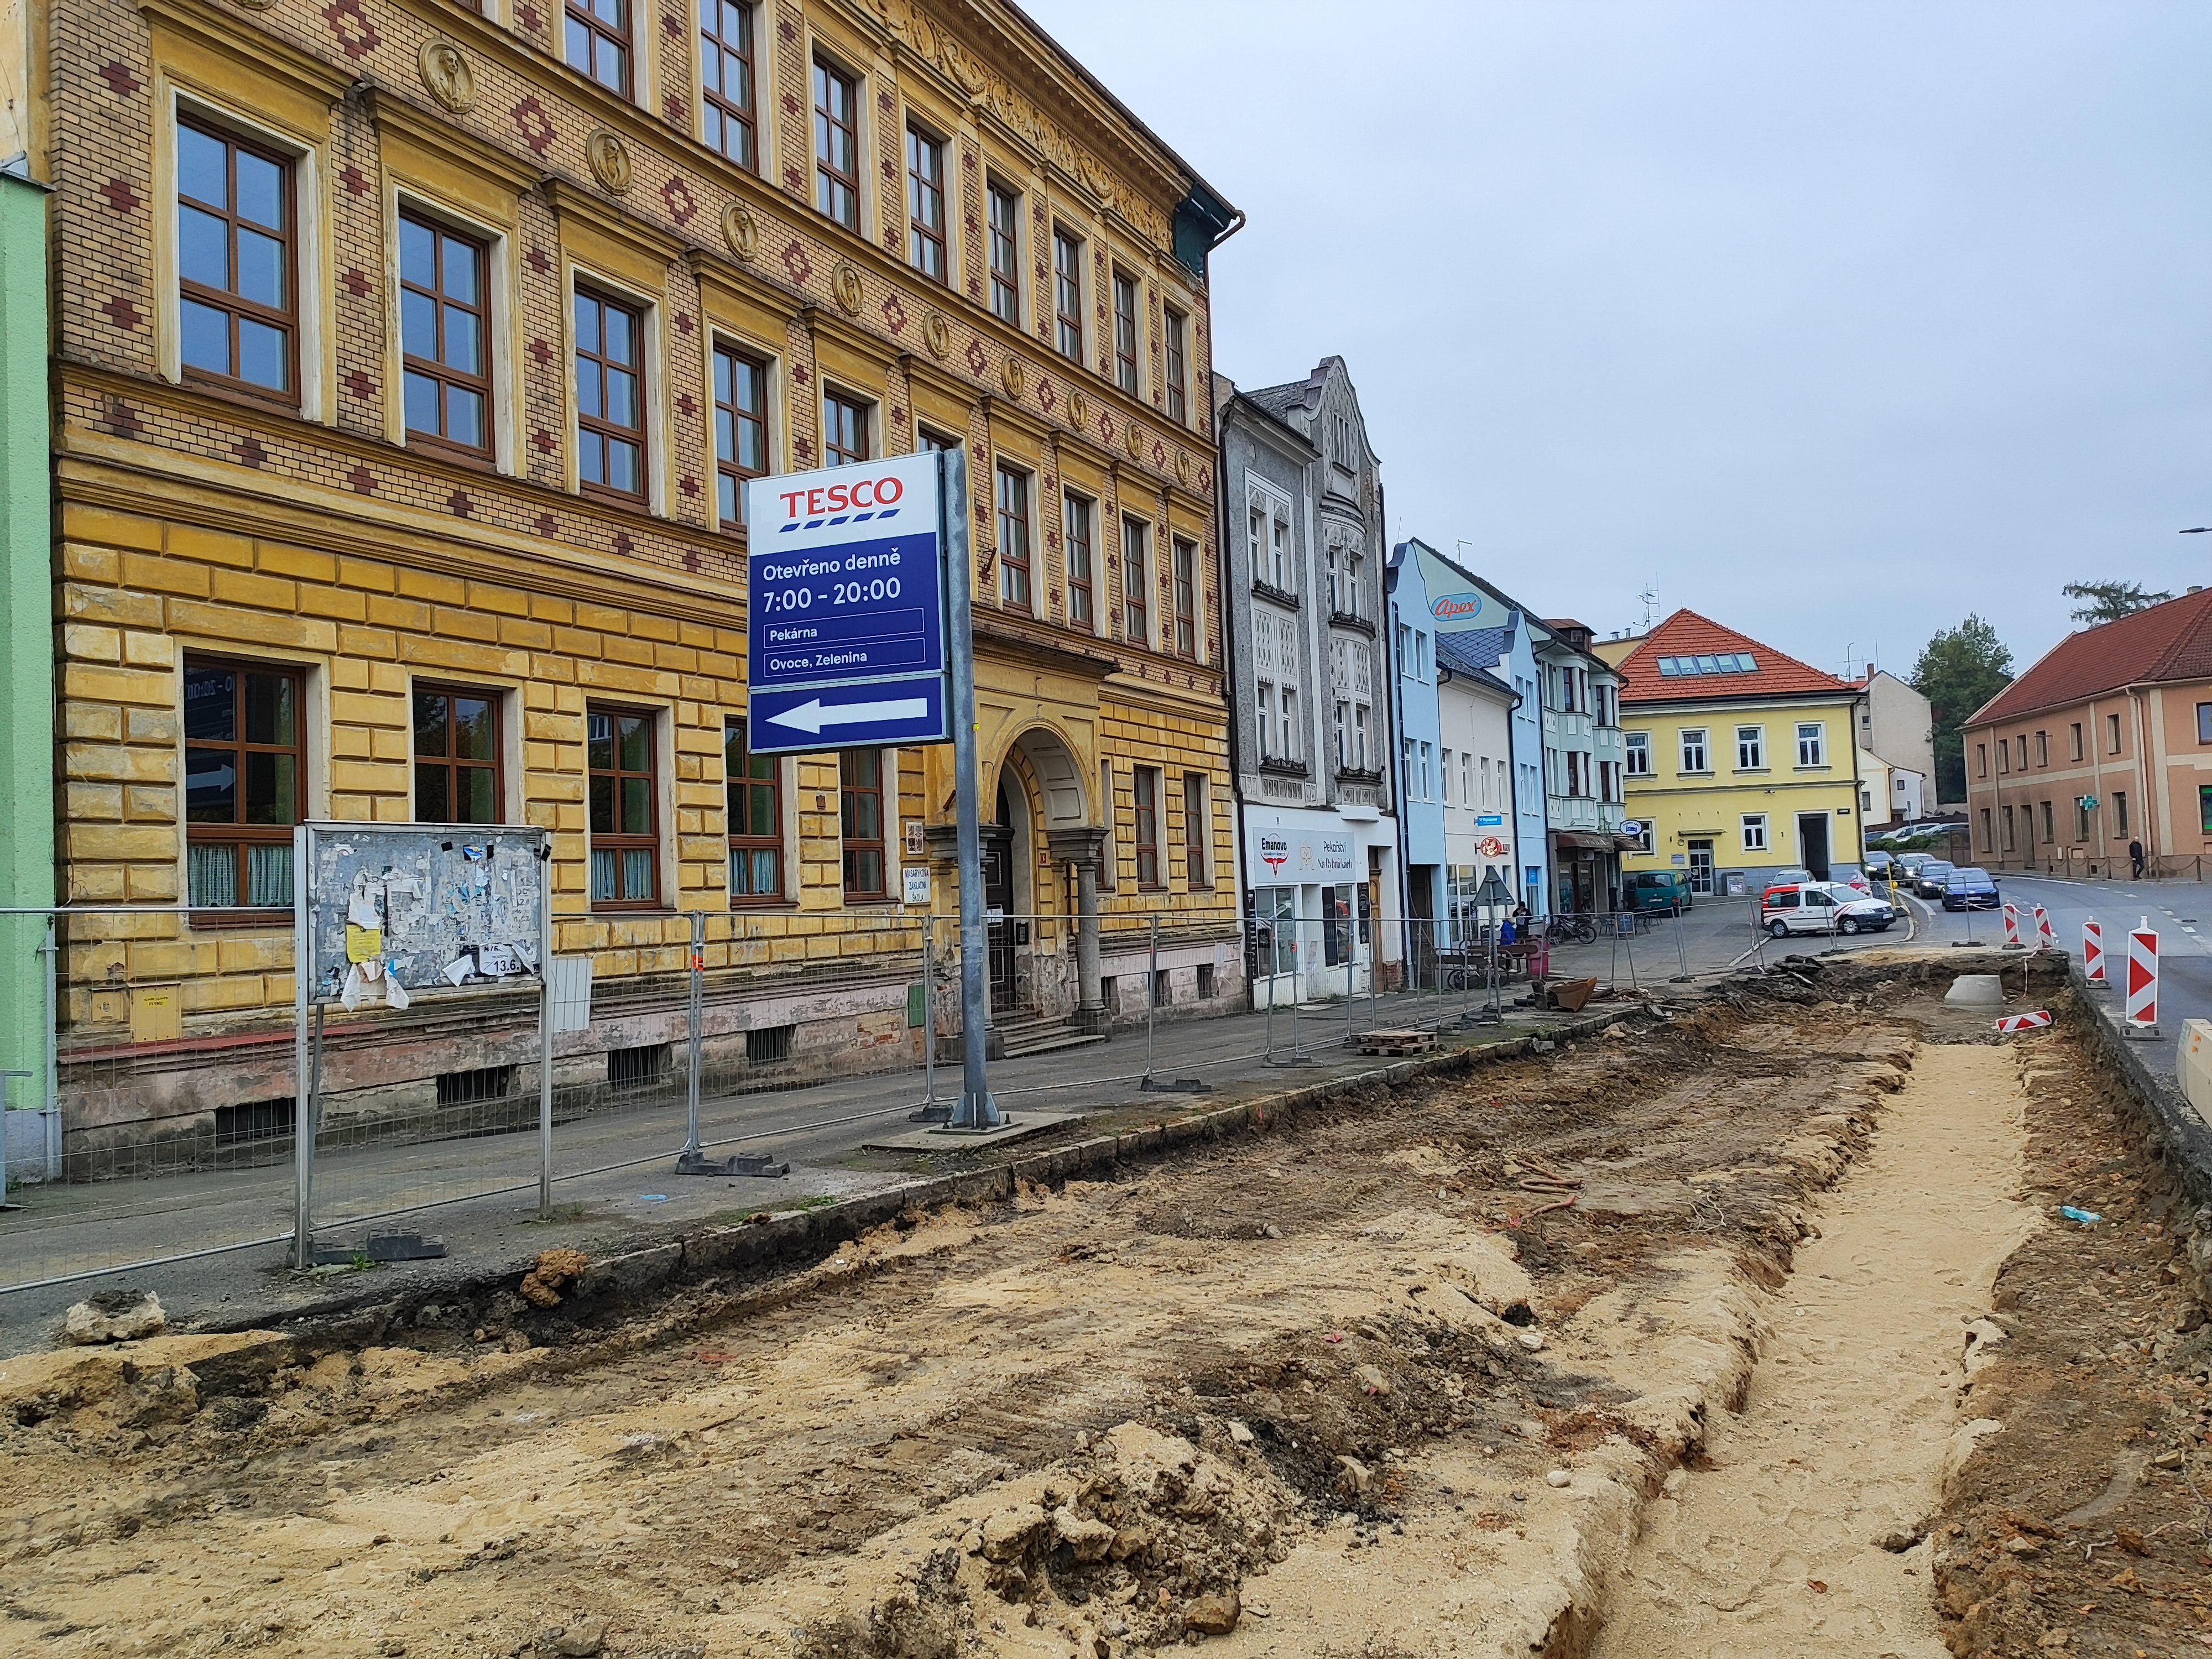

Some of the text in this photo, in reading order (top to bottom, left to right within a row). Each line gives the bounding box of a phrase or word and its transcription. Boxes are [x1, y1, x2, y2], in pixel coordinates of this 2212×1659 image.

[780, 477, 903, 518] TESCO
[764, 547, 901, 581] Otevřeno denně
[763, 587, 811, 612] 7:00
[833, 577, 901, 604] 20:00
[770, 627, 817, 641] Pekárna
[770, 651, 867, 671] Ovoce, Zelenina
[1261, 837, 1287, 851] Emanovo
[1323, 841, 1347, 852] Pekařství
[494, 959, 519, 972] 13.6.
